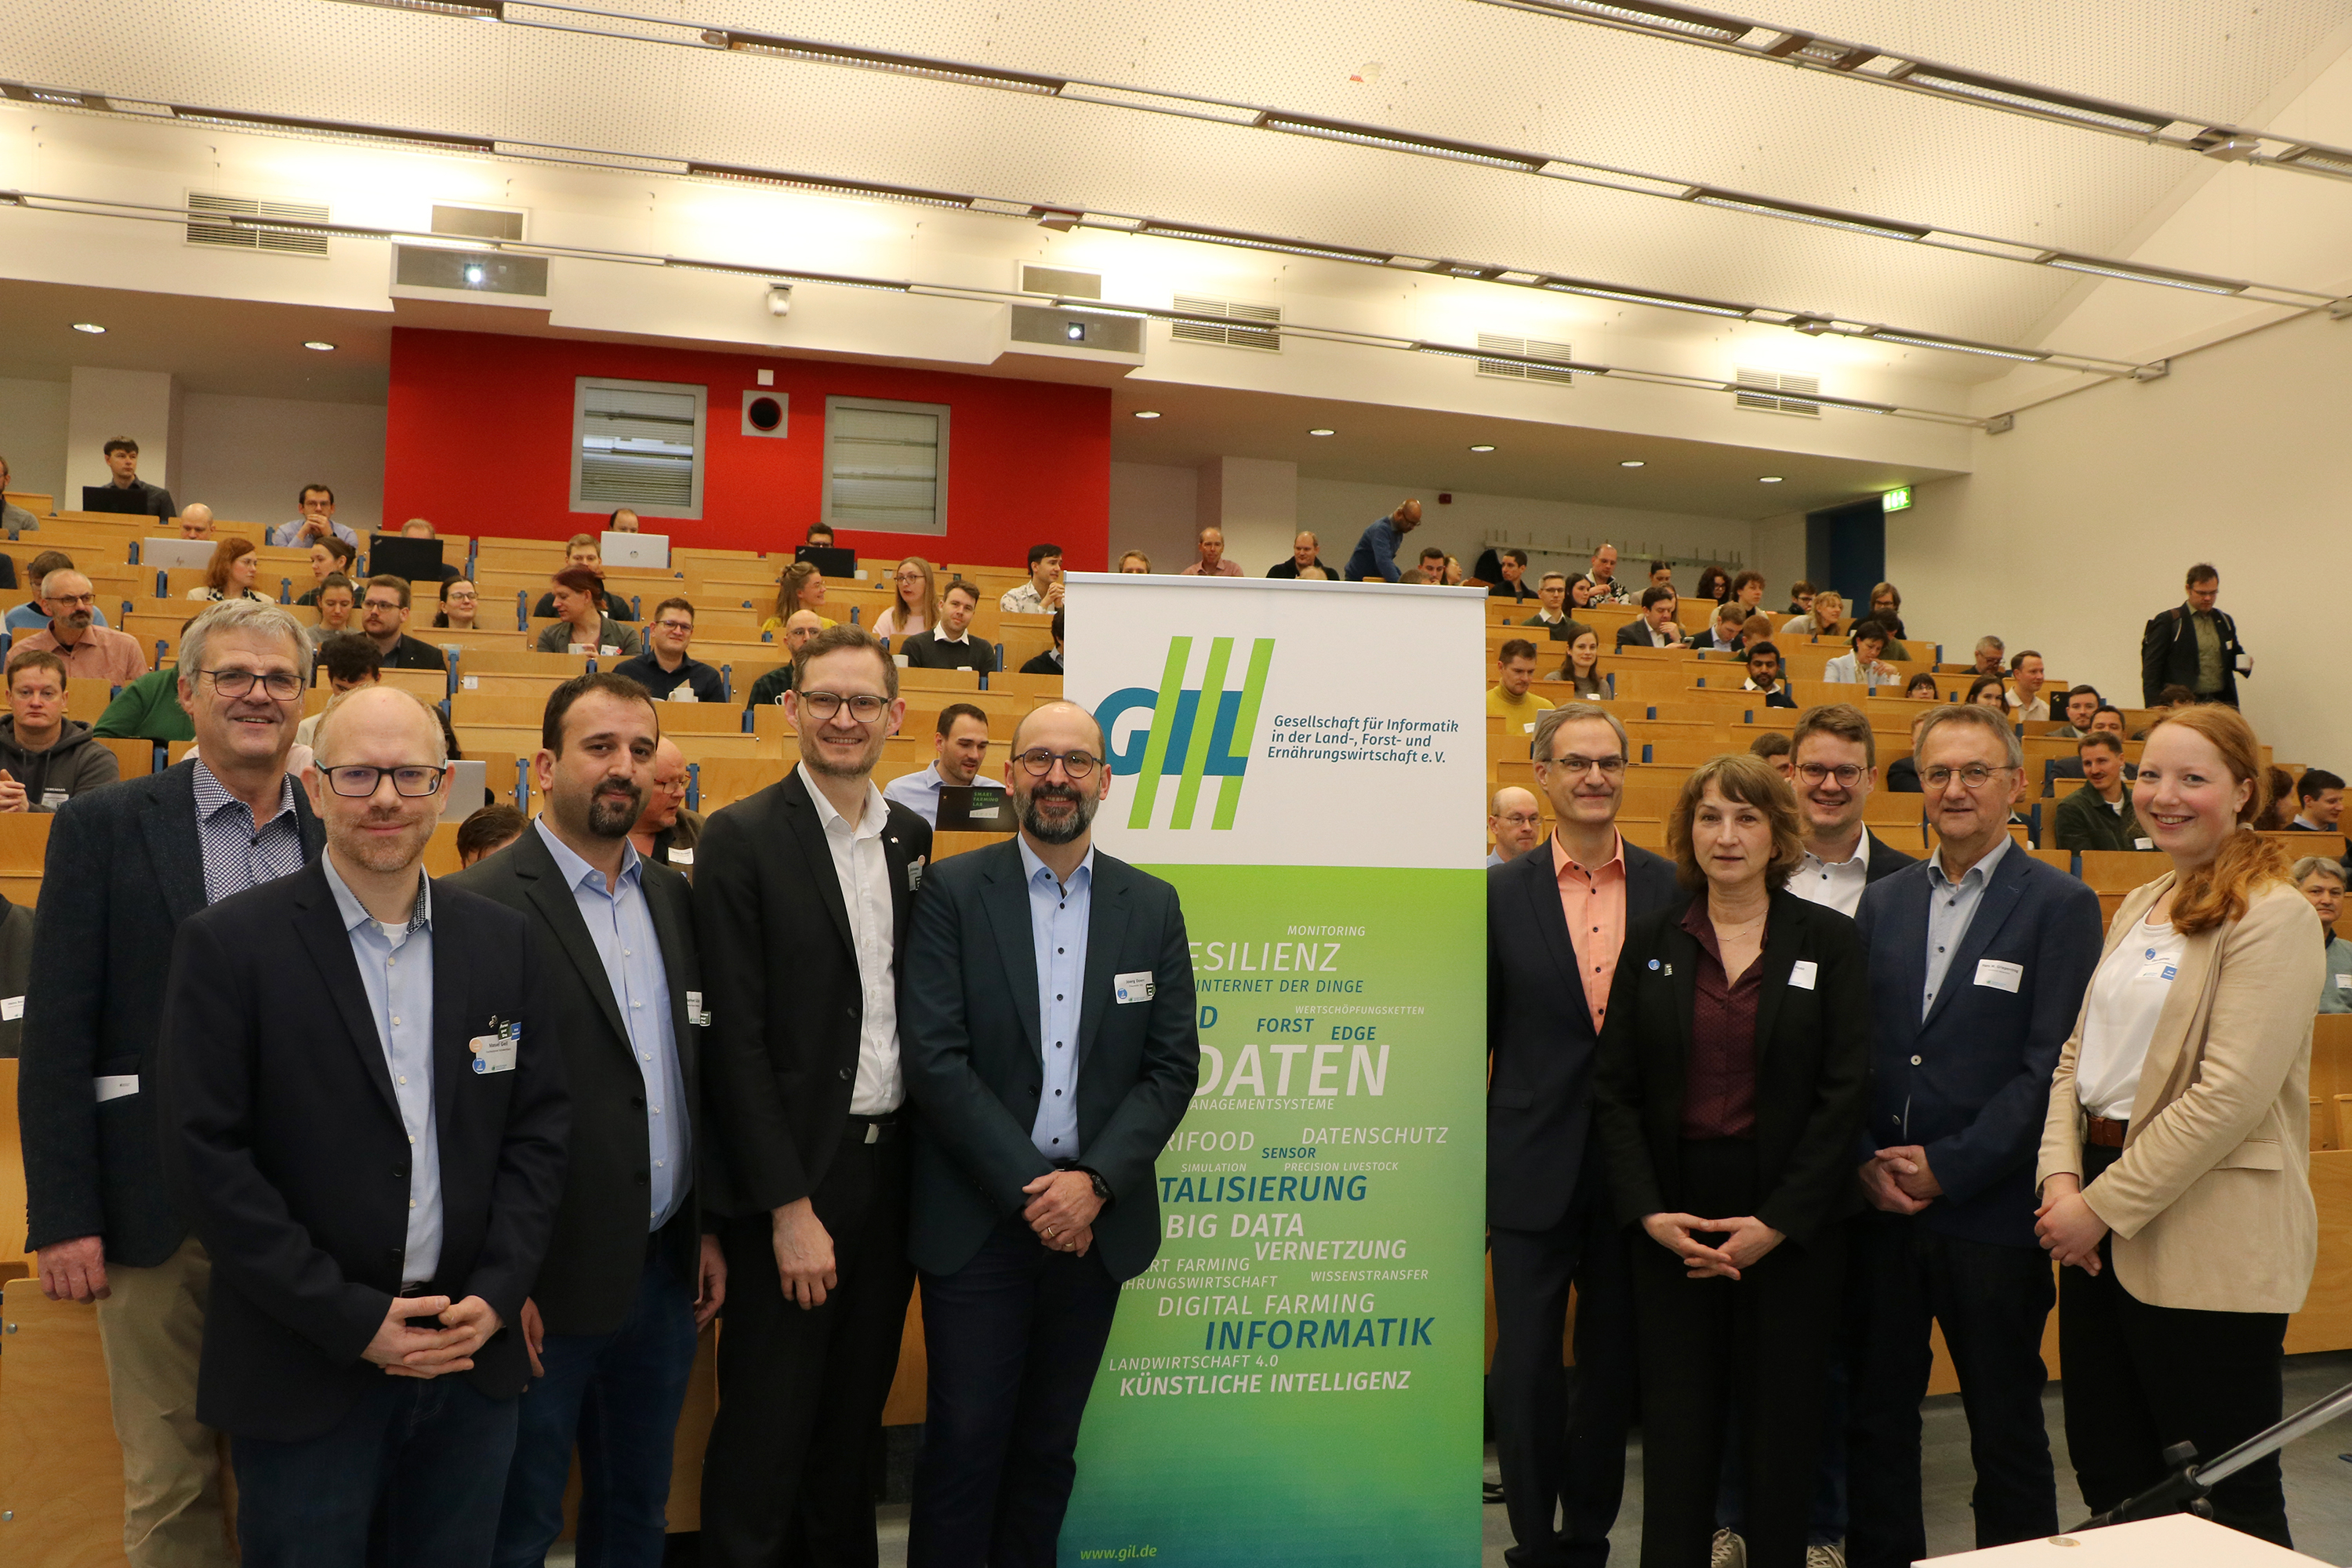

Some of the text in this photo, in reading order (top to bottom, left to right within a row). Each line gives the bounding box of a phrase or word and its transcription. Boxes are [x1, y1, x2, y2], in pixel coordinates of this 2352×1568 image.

[1093, 688, 1248, 776] GIL
[1274, 715, 1458, 733] Gesellschaft für Informatik
[1272, 731, 1431, 747] in der Land-, Forst- und
[1268, 746, 1446, 764] Ernährungswirtschaft e. V.
[1287, 925, 1365, 936] MONITORING
[1189, 942, 1341, 971] ESILIENZ
[1196, 979, 1363, 993] INTERNET DER DINGE
[1295, 1004, 1425, 1014] WERTSCHÖPFUNGSKETTEN
[1257, 1018, 1314, 1033] FORST
[1331, 1026, 1376, 1040] EDGE
[1189, 1099, 1334, 1110] ANAGEMENTSYSTEME
[1163, 1131, 1254, 1151] RIFOOD
[1302, 1127, 1448, 1144] DATENSCHUTZ
[1261, 1147, 1316, 1159] SENSOR
[1181, 1163, 1247, 1172] SIMULATION
[1284, 1162, 1398, 1171] PRECISION LIVESTOCK
[1160, 1175, 1367, 1203] TALISIERUNG
[1166, 1213, 1304, 1239] BIG DATA
[1255, 1240, 1406, 1261] VERNETZUNG
[1177, 1258, 1250, 1272] FARMING
[1122, 1276, 1277, 1290] HRUNGSWIRTSCHAFT
[1311, 1269, 1428, 1282] WISSENSTRANSFER
[1158, 1294, 1374, 1316] DIGITAL FARMING
[1206, 1318, 1435, 1350] INFORMATIK
[1109, 1355, 1278, 1370] LANDWIRTSCHAFT 4.0
[1120, 1371, 1410, 1396] KÜNSTLICHE INTELLIGENZ
[1080, 1544, 1157, 1562] www.gil.de
